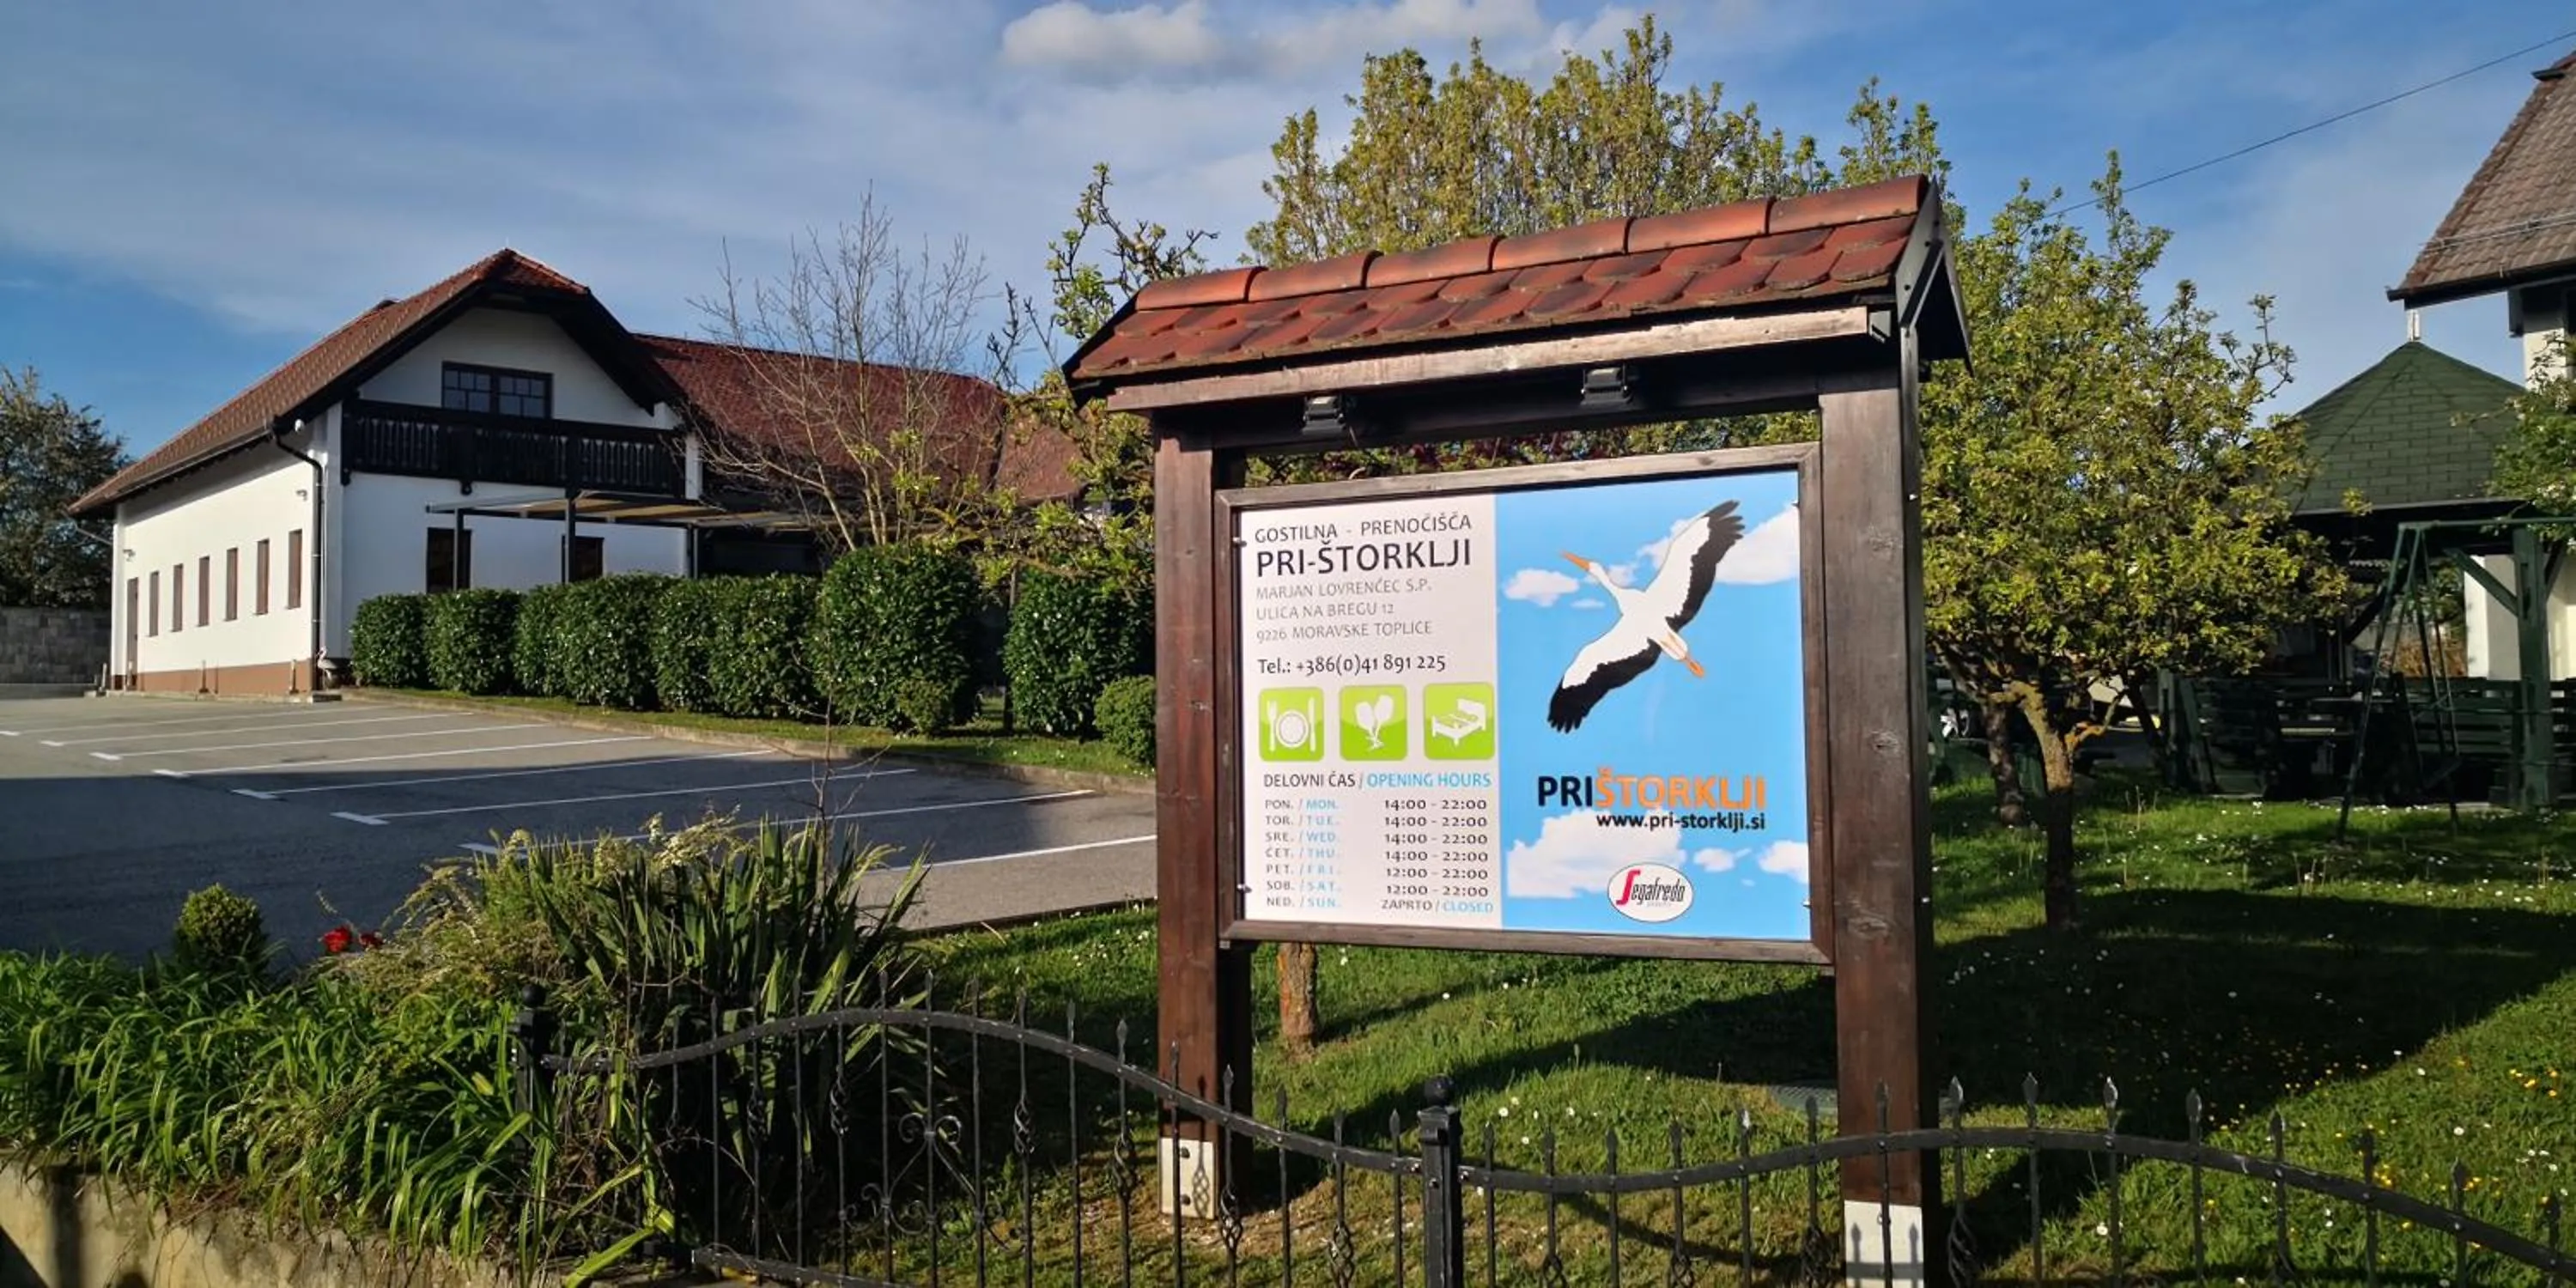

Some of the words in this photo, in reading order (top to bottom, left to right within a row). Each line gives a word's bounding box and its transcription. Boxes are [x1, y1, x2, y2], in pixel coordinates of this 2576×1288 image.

[1255, 523, 1338, 544] GOSTILNA
[1361, 512, 1472, 536] PRENOČIŠČA
[1257, 538, 1471, 577] PRI-ŠTORKLJI
[1255, 585, 1313, 600] MARJAN
[1406, 578, 1431, 592] S.P.
[1256, 605, 1298, 621] ULICA
[1302, 605, 1323, 617] NA
[1327, 603, 1376, 617] BREGU
[1382, 604, 1394, 615] 12
[1256, 629, 1287, 644] 9226
[1292, 623, 1369, 641] MORAVSKE
[1374, 621, 1432, 635] TOPLICE
[1257, 659, 1291, 674] Tel.:
[1297, 653, 1377, 677] +386(0)41
[1383, 653, 1411, 671] 891
[1418, 654, 1446, 672] 225
[1264, 774, 1324, 787] DELOVNI
[1328, 771, 1356, 787] ČAS
[1367, 773, 1433, 787] OPENING
[1437, 773, 1491, 787] HOURS
[1384, 799, 1426, 811] 14:00
[1442, 799, 1487, 811] 22:00
[1385, 817, 1427, 829] 14:00
[1442, 817, 1487, 828] 22:00
[1596, 811, 1765, 833] www.pri-storklji.si
[1385, 834, 1427, 845] 14:00
[1443, 834, 1488, 846] 22:00
[1386, 851, 1428, 862] 14:00
[1443, 851, 1488, 863] 22:00
[1387, 867, 1428, 878] 12:00
[1443, 868, 1488, 880] 22:00
[1387, 885, 1429, 896] 12:00
[1443, 886, 1488, 897] 22:00
[1616, 870, 1686, 905] Segafredo
[1267, 896, 1295, 908] NED.
[1381, 900, 1432, 911] ZAPRTO
[1443, 902, 1493, 914] CLOSED
